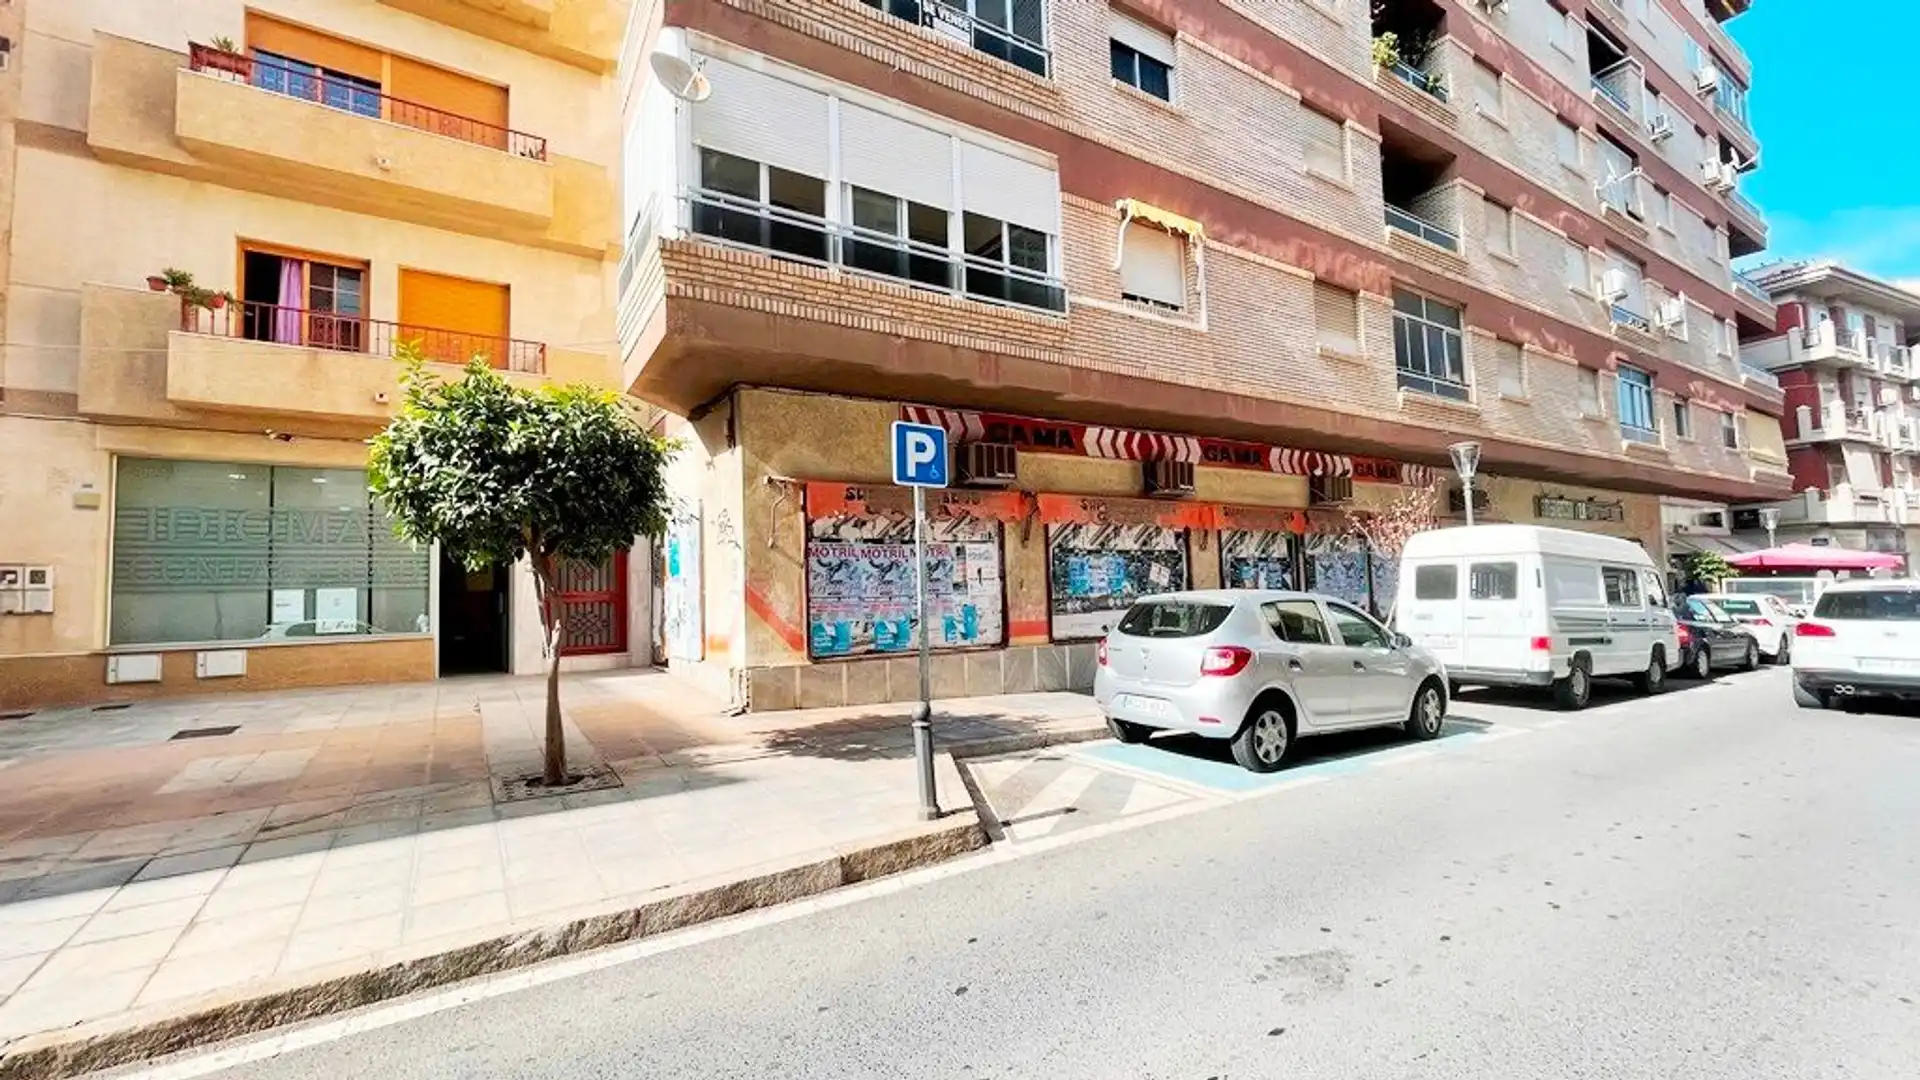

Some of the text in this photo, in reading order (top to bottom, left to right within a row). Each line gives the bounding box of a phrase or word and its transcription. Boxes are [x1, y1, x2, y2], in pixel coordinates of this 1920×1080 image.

[989, 422, 1077, 449] GAMA
[906, 431, 936, 477] P
[1204, 444, 1264, 464] GAMA
[1354, 462, 1399, 479] GAMA
[808, 547, 859, 558] MOTRIL
[861, 549, 908, 559] MOTRIL
